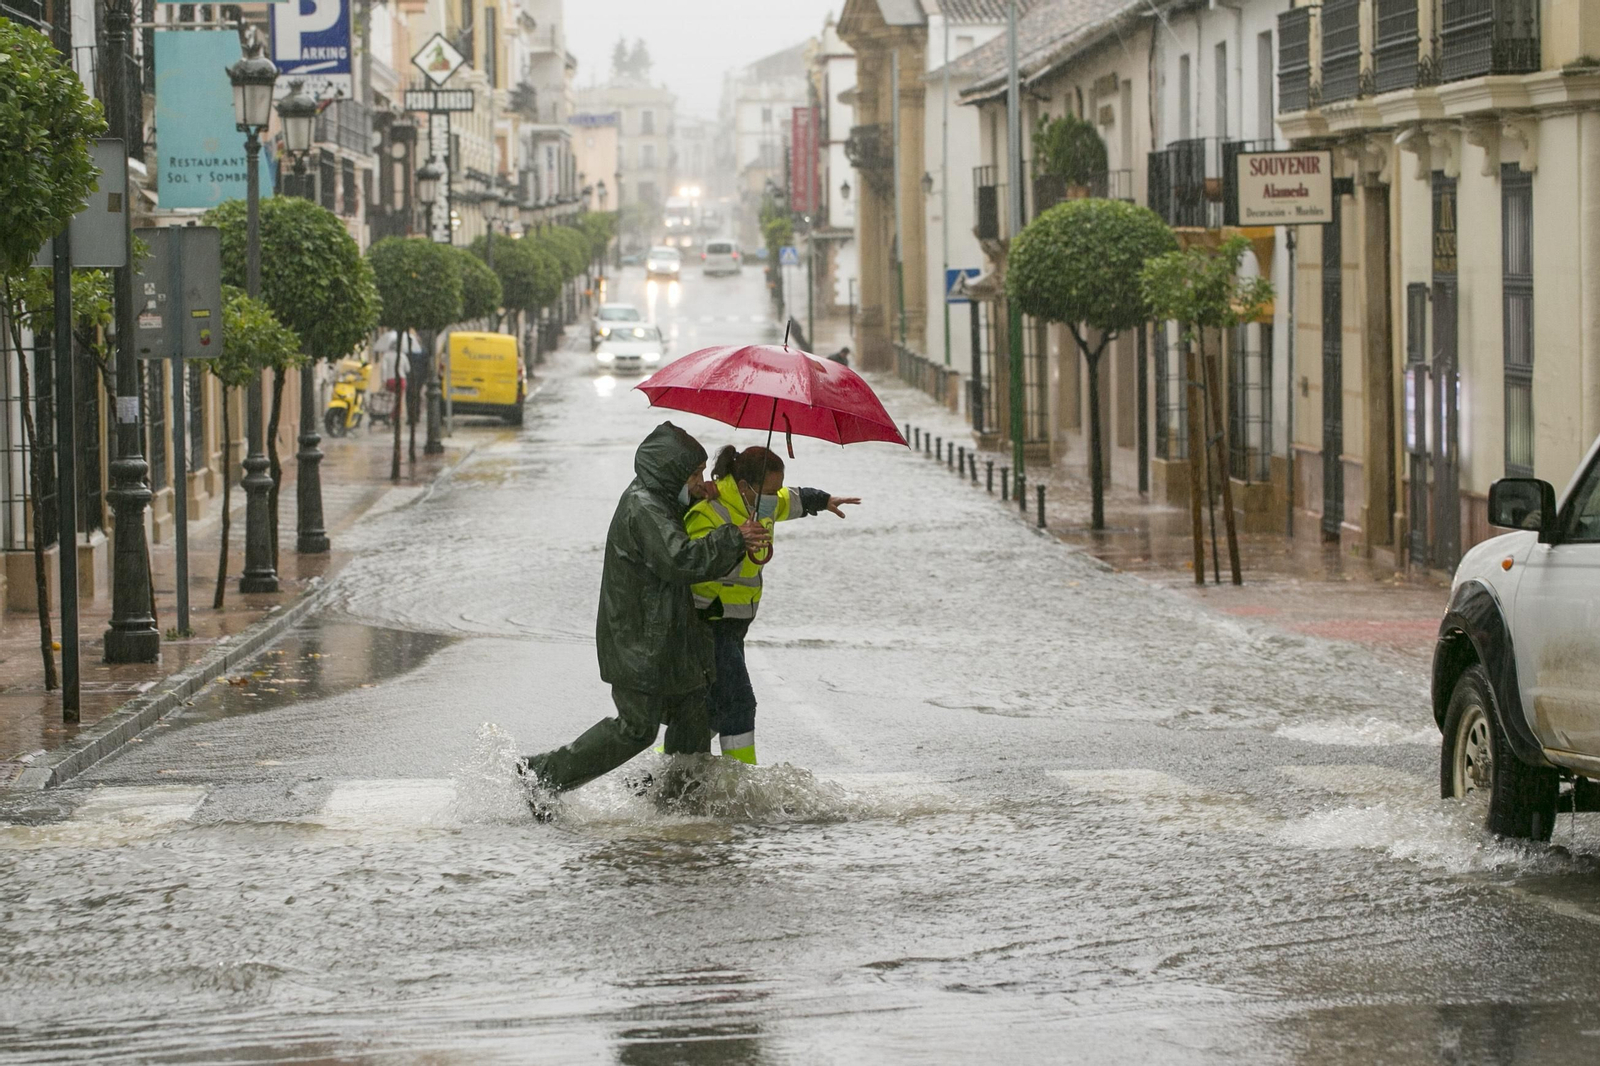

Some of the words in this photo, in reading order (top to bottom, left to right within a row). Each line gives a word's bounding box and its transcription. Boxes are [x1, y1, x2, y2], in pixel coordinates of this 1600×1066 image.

[169, 156, 247, 168] RESTAURANT
[1249, 155, 1321, 176] SOUVENIR
[167, 172, 188, 183] SOL
[197, 174, 203, 182] Y
[209, 171, 248, 182] SOMBR
[1263, 182, 1309, 198] Alameda
